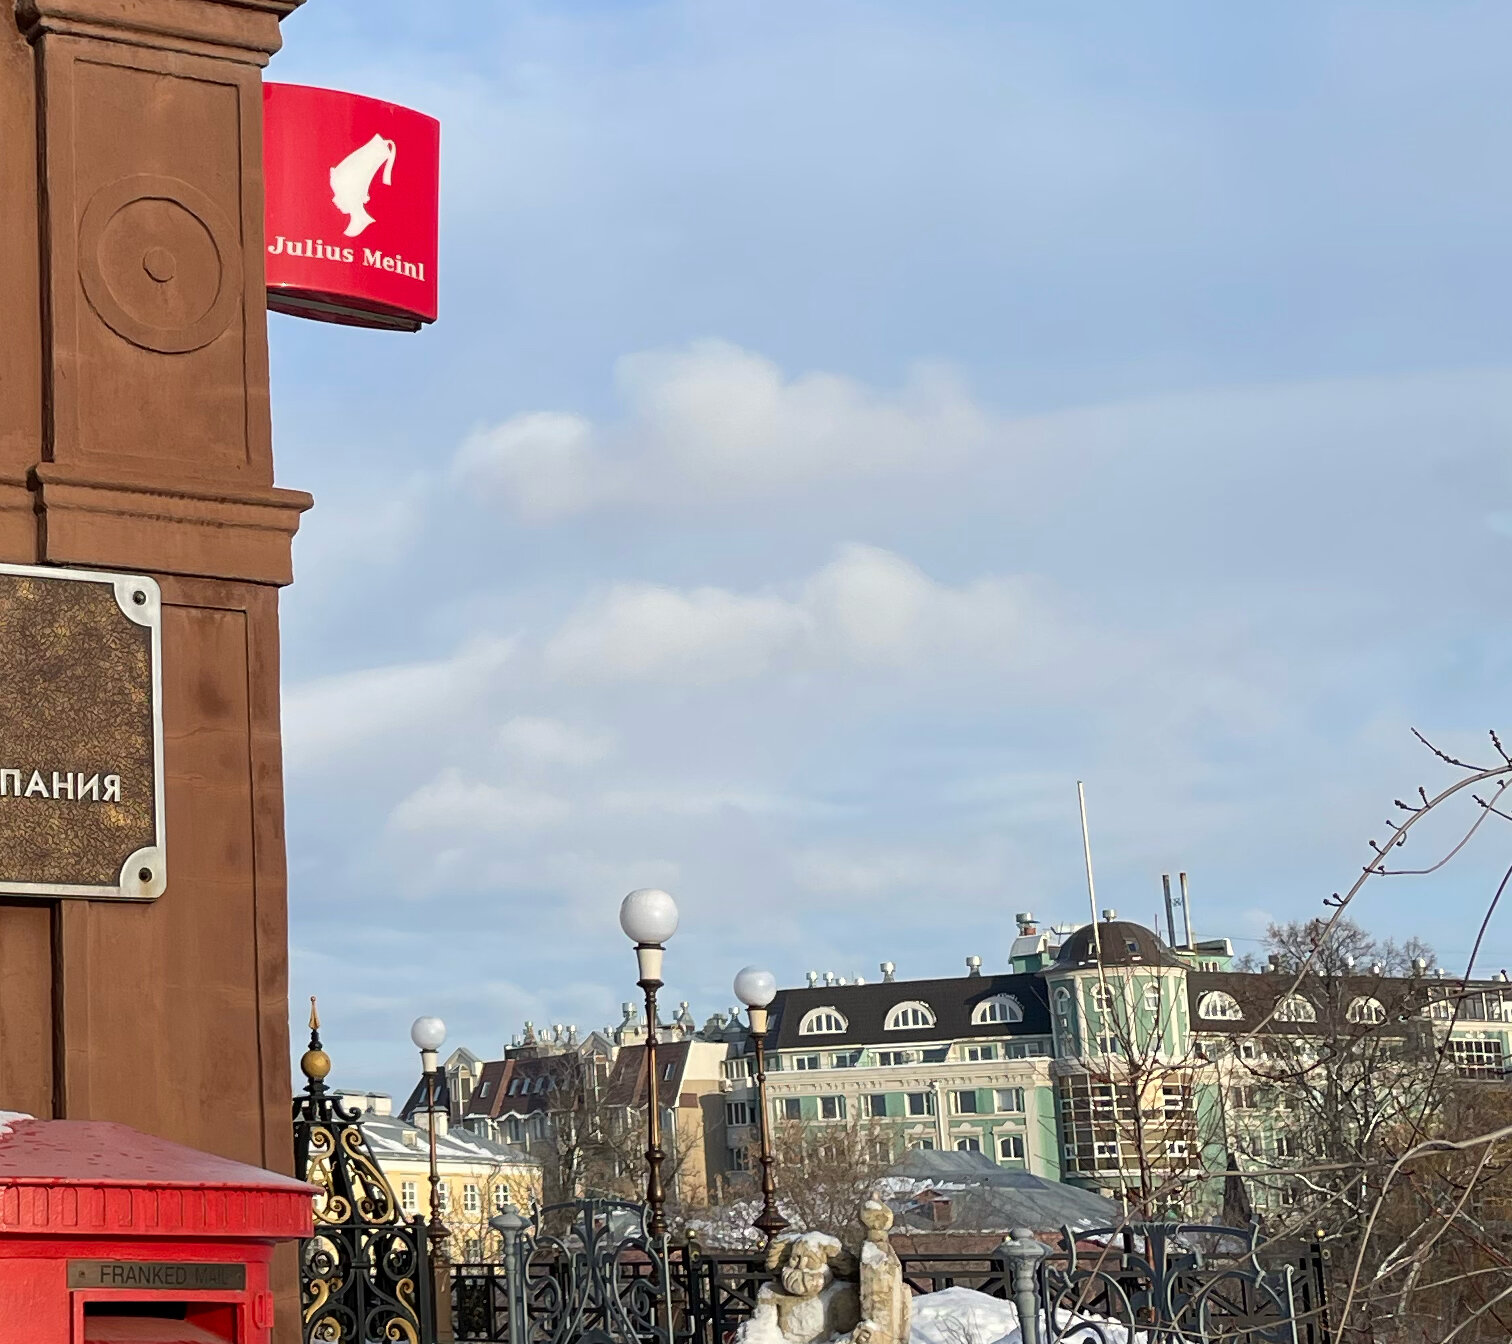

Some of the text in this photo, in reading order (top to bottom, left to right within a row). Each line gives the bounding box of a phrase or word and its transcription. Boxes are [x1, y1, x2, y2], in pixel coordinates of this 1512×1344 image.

[268, 236, 425, 282] Julius Meinl
[100, 1265, 228, 1285] FRANKED MAIL
